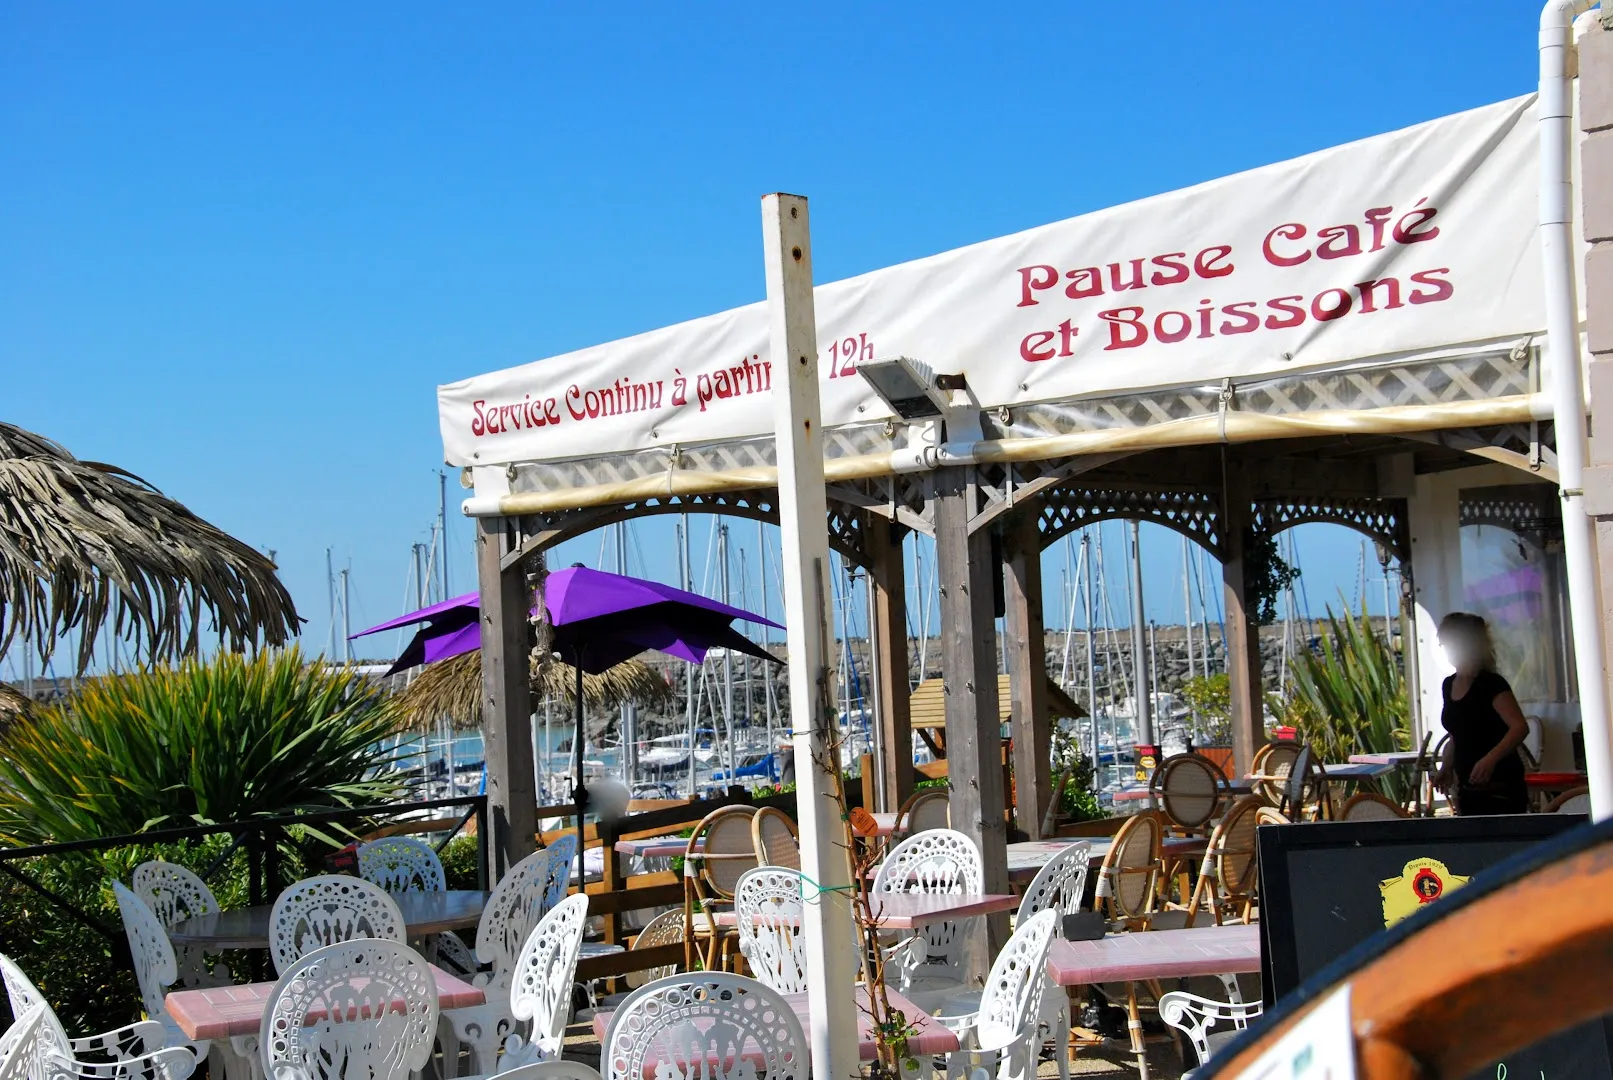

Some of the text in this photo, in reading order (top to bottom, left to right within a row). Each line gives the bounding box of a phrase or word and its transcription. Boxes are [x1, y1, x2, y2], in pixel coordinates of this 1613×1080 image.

[1017, 198, 1440, 308] Pause Café
[1019, 267, 1453, 363] et Boissons
[472, 332, 874, 437] Service Continu à partir 12h
